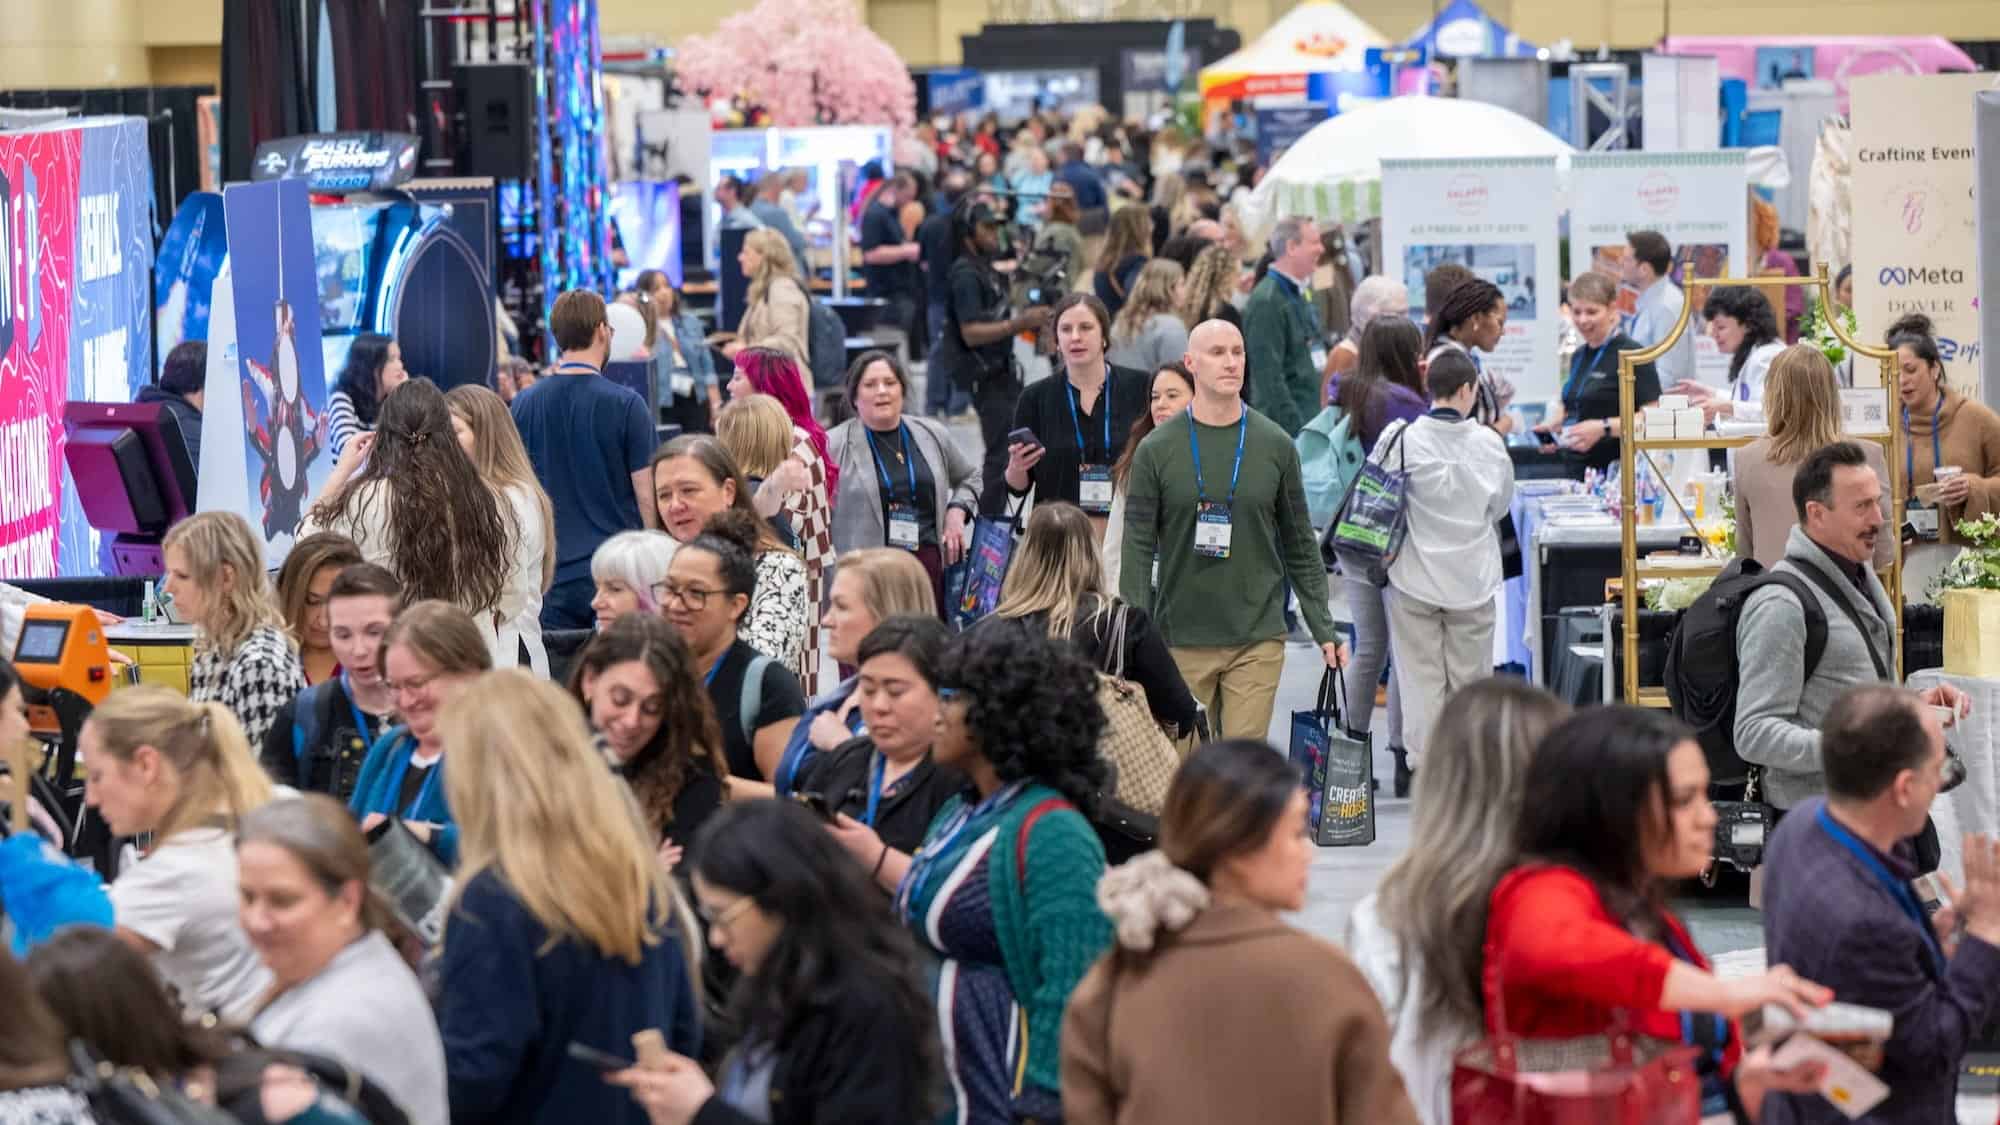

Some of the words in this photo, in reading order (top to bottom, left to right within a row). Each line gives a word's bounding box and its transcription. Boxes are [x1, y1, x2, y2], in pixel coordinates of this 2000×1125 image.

[1859, 147, 1926, 162] Crafting
[1908, 267, 1964, 285] Meta
[1888, 300, 1954, 313] DOVER
